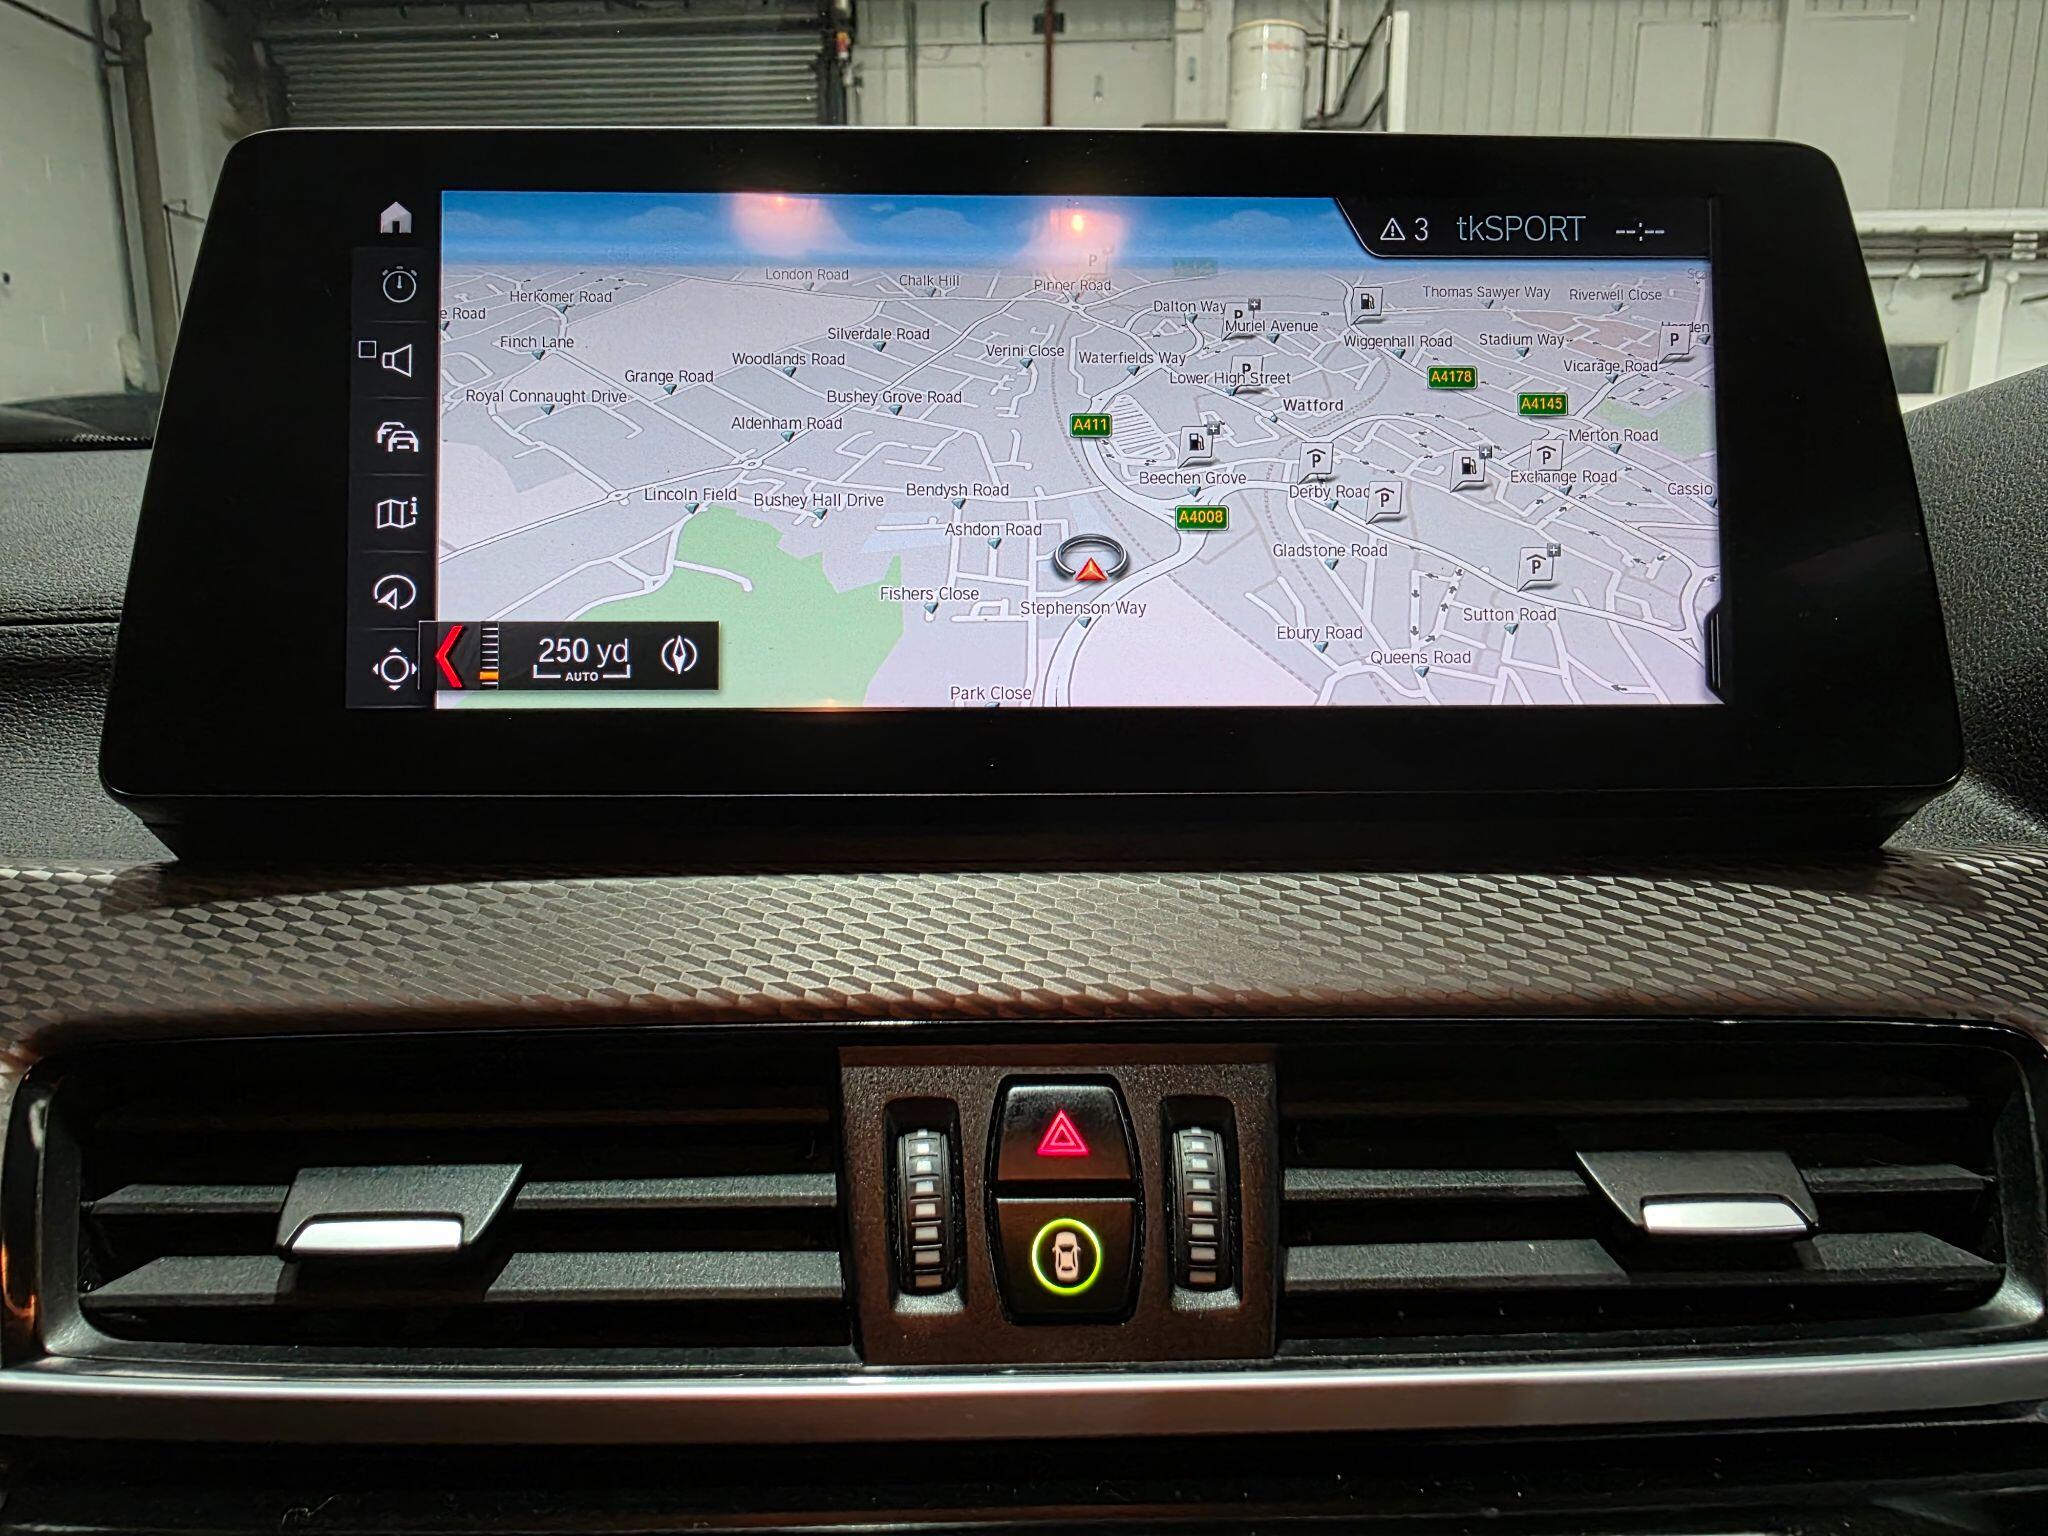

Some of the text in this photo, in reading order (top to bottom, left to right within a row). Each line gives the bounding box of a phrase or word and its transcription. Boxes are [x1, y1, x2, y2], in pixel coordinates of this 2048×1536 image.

[1415, 218, 1428, 240] 3
[1457, 216, 1586, 241] tkSPORT
[766, 269, 848, 281] London Road
[900, 275, 960, 287] Chalk Hill
[1034, 279, 1111, 291] Pinner Road
[510, 290, 612, 304] Herkomer Road
[1423, 286, 1550, 301] Thomas Sawyer Way
[1570, 288, 1662, 300] Riverwell Close
[453, 307, 486, 319] Road
[1154, 300, 1226, 315] Dalton Way
[1226, 320, 1318, 332] Muriel Avenue
[828, 327, 930, 340] Silverdale Road
[500, 336, 574, 348] Finch Lane
[1344, 335, 1452, 352] Wiggenhall Road
[1480, 334, 1564, 350] Stadium Way
[986, 345, 1065, 357] Verini Close
[732, 352, 845, 366] Woodlands Road
[1079, 351, 1186, 367] Waterfields Way
[1564, 360, 1658, 376] Vicarage Road
[625, 370, 714, 386] Grange Road
[1170, 372, 1290, 387] Lower High Street
[1432, 370, 1472, 383] A4178
[466, 390, 627, 404] Royal Connaught Drive
[827, 390, 962, 406] Bushey Grove Road
[1283, 399, 1343, 412] Watford
[1521, 398, 1562, 410] A4145
[732, 417, 842, 430] Aldenham Road
[1074, 418, 1107, 431] A411
[1569, 430, 1658, 442] Merton Road
[1140, 472, 1246, 484] Beechen Grove
[1510, 471, 1617, 486] Exchange Road
[644, 488, 736, 501] Lincoln Field
[906, 484, 1008, 499] Bendysh Road
[1290, 486, 1330, 500] Derby
[1668, 482, 1712, 495] Cassio
[754, 494, 884, 509] Bushey Hall Drive
[1179, 511, 1222, 523] A4008
[945, 524, 1042, 536] Ashdon Road
[1273, 544, 1388, 557] Gladstone Road
[880, 587, 979, 600] Fishers Close
[1021, 602, 1146, 618] Stephenson Way
[1464, 608, 1556, 621] Sutton Road
[1278, 626, 1362, 642] Ebury Road
[538, 638, 629, 668] 250 yd
[1370, 651, 1471, 664] Queens Road
[566, 672, 598, 682] AUTO
[951, 687, 1032, 700] Park Close
